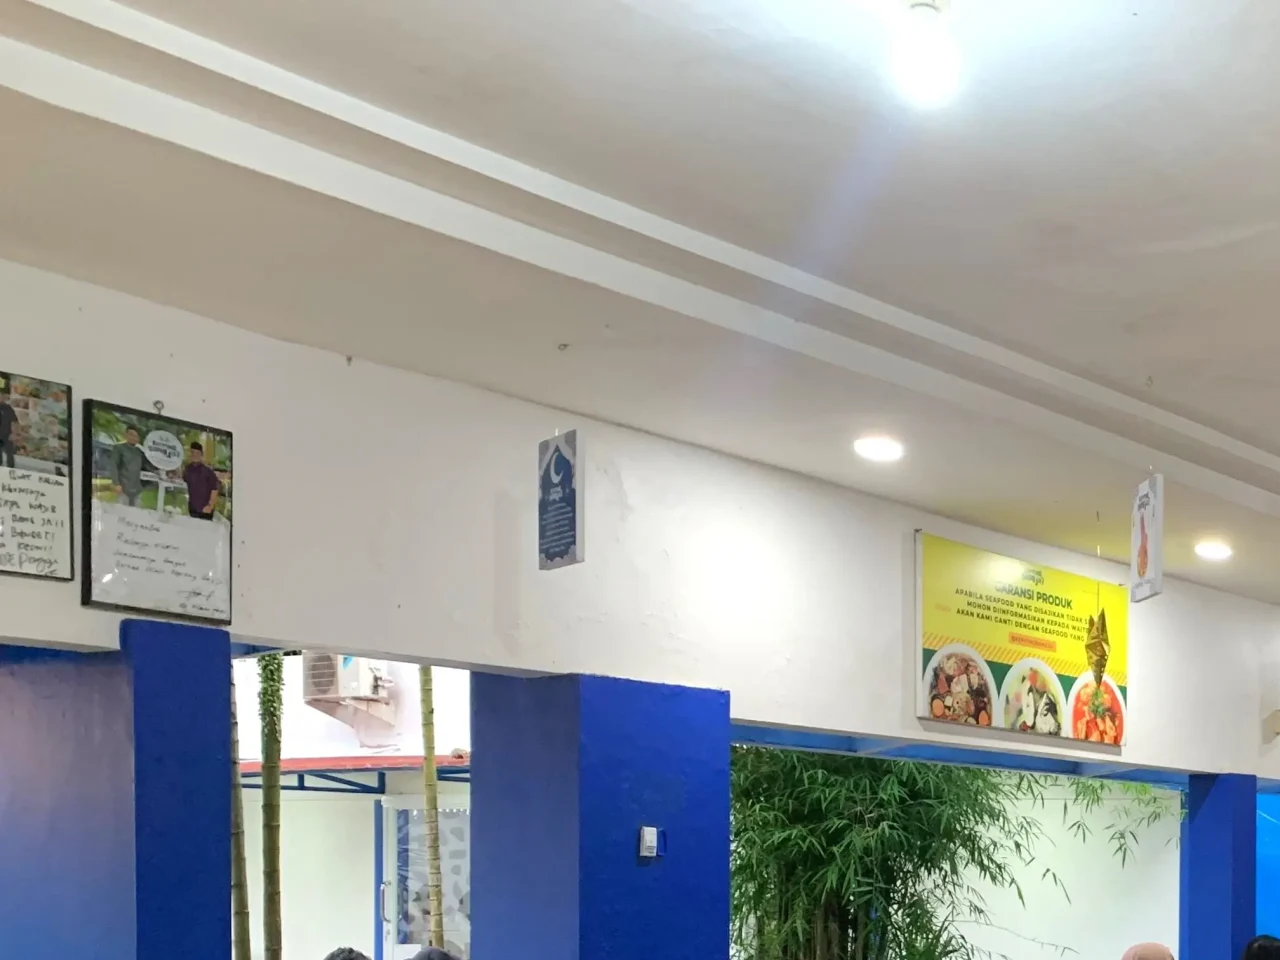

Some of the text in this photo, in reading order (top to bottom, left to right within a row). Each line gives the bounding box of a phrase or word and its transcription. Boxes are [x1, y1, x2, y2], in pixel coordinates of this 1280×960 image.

[955, 588, 983, 601] APABILA
[985, 595, 1015, 608] SEAFOOD
[1016, 602, 1033, 613] YANG
[1034, 606, 1065, 620] DISAJIKAN
[995, 581, 1073, 610] GARANSI PRODUK
[956, 608, 1085, 643] AKAN KAMI GANTI DENGAN SEAFOOD YANG
[967, 600, 991, 611] MOHON
[992, 606, 1045, 624] DIINFORMASIKAN
[1046, 618, 1070, 630] KEPADA
